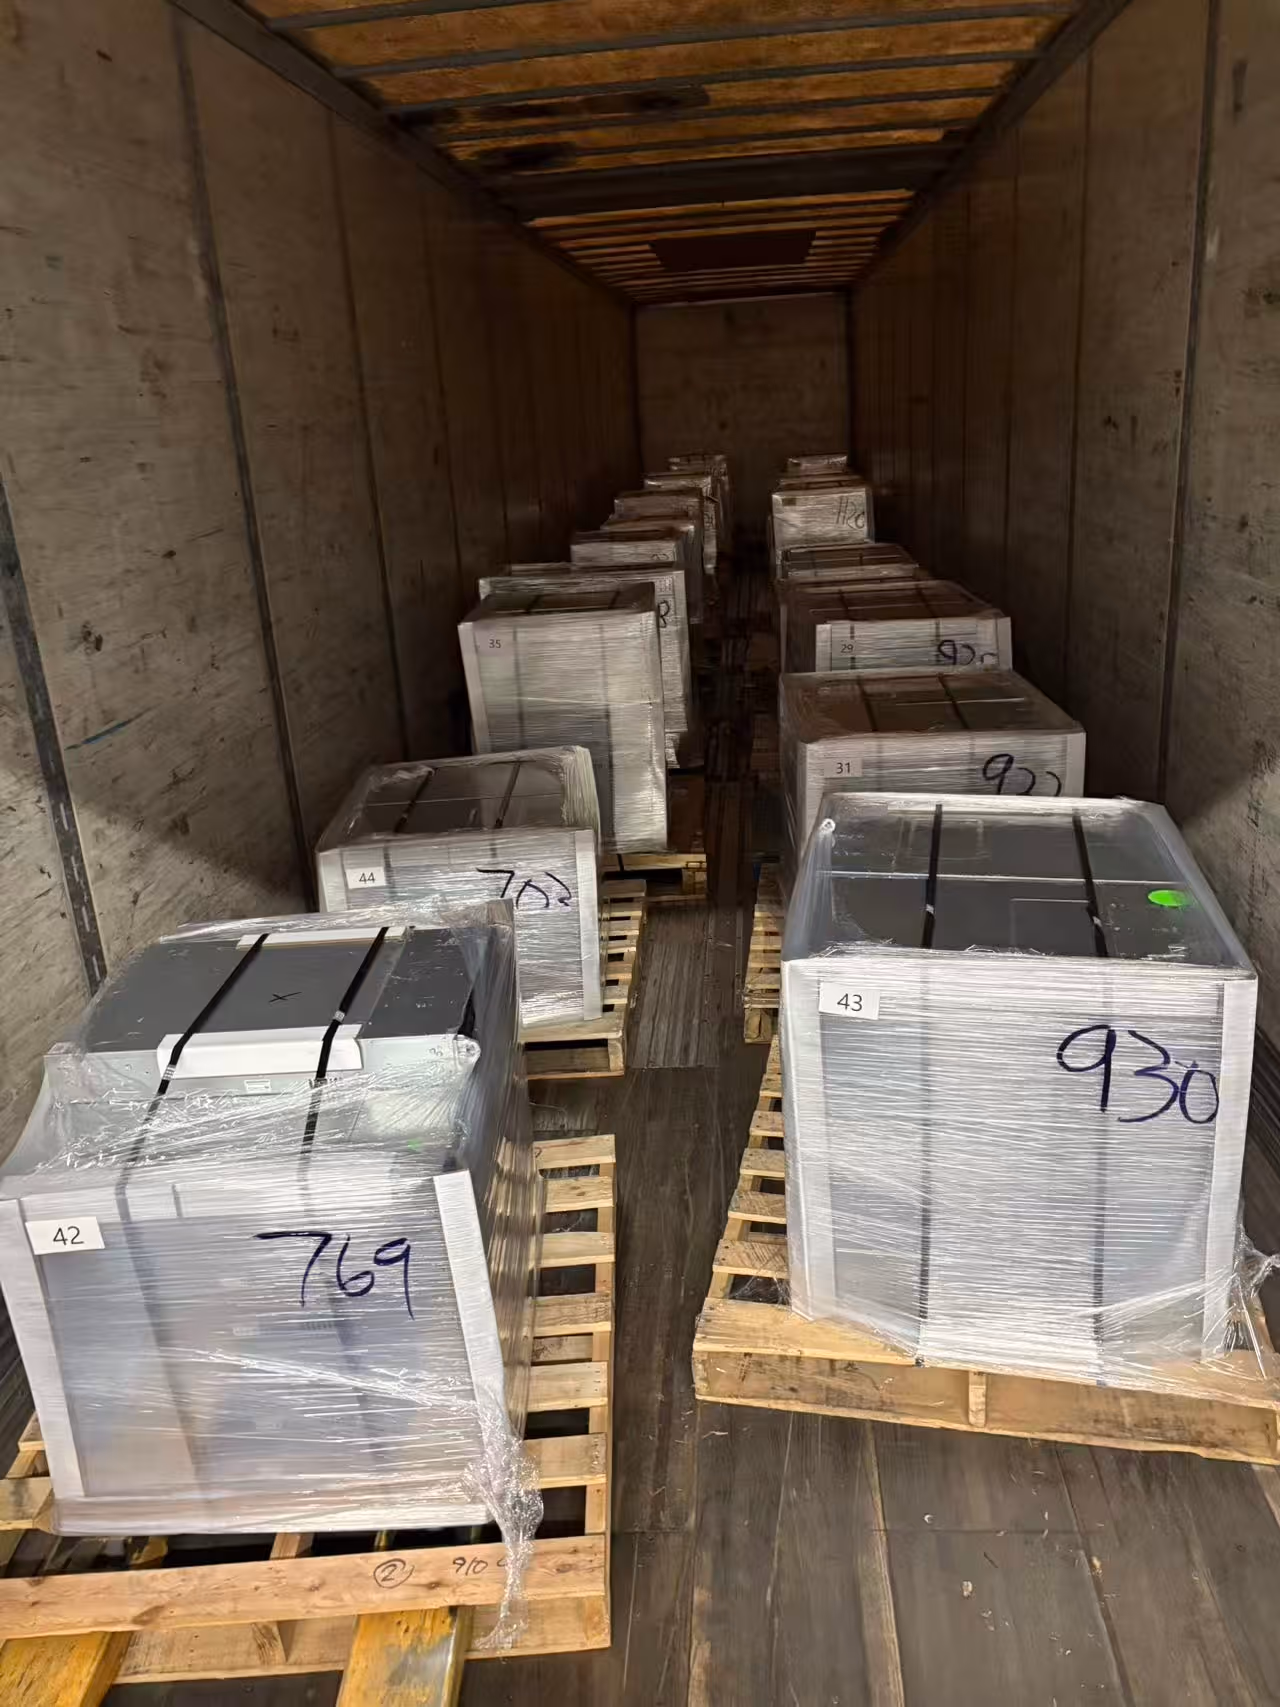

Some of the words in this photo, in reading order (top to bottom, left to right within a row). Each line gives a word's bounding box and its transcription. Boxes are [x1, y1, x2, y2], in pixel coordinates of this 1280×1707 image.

[488, 639, 502, 649] 35
[840, 643, 854, 654] 29
[836, 762, 851, 774] 31
[359, 871, 376, 884] 44
[837, 993, 863, 1012] 43
[1056, 1024, 1219, 1124] 930
[52, 1225, 85, 1246] 42
[253, 1230, 415, 1320] 769
